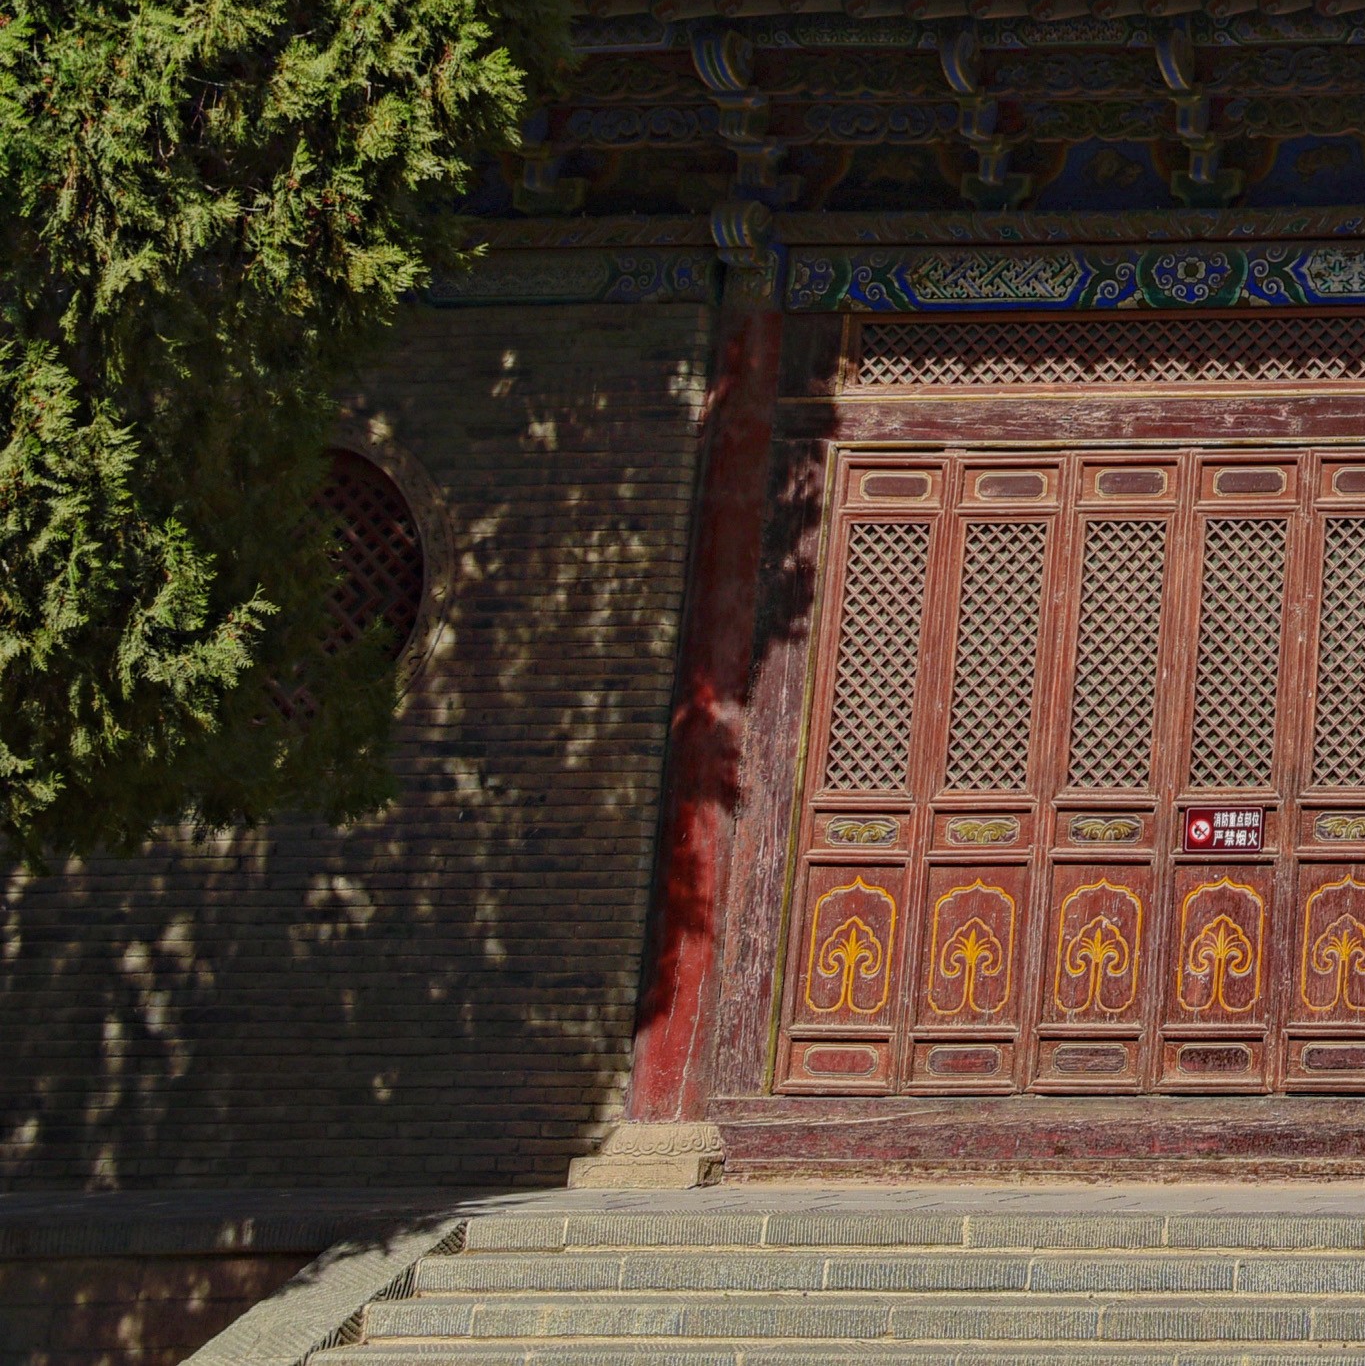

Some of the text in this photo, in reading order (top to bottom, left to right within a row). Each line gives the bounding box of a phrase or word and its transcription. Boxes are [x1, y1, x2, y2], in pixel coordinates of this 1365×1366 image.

[1212, 811, 1261, 828] 消防重点部位
[1212, 828, 1259, 847] 严禁烟火
